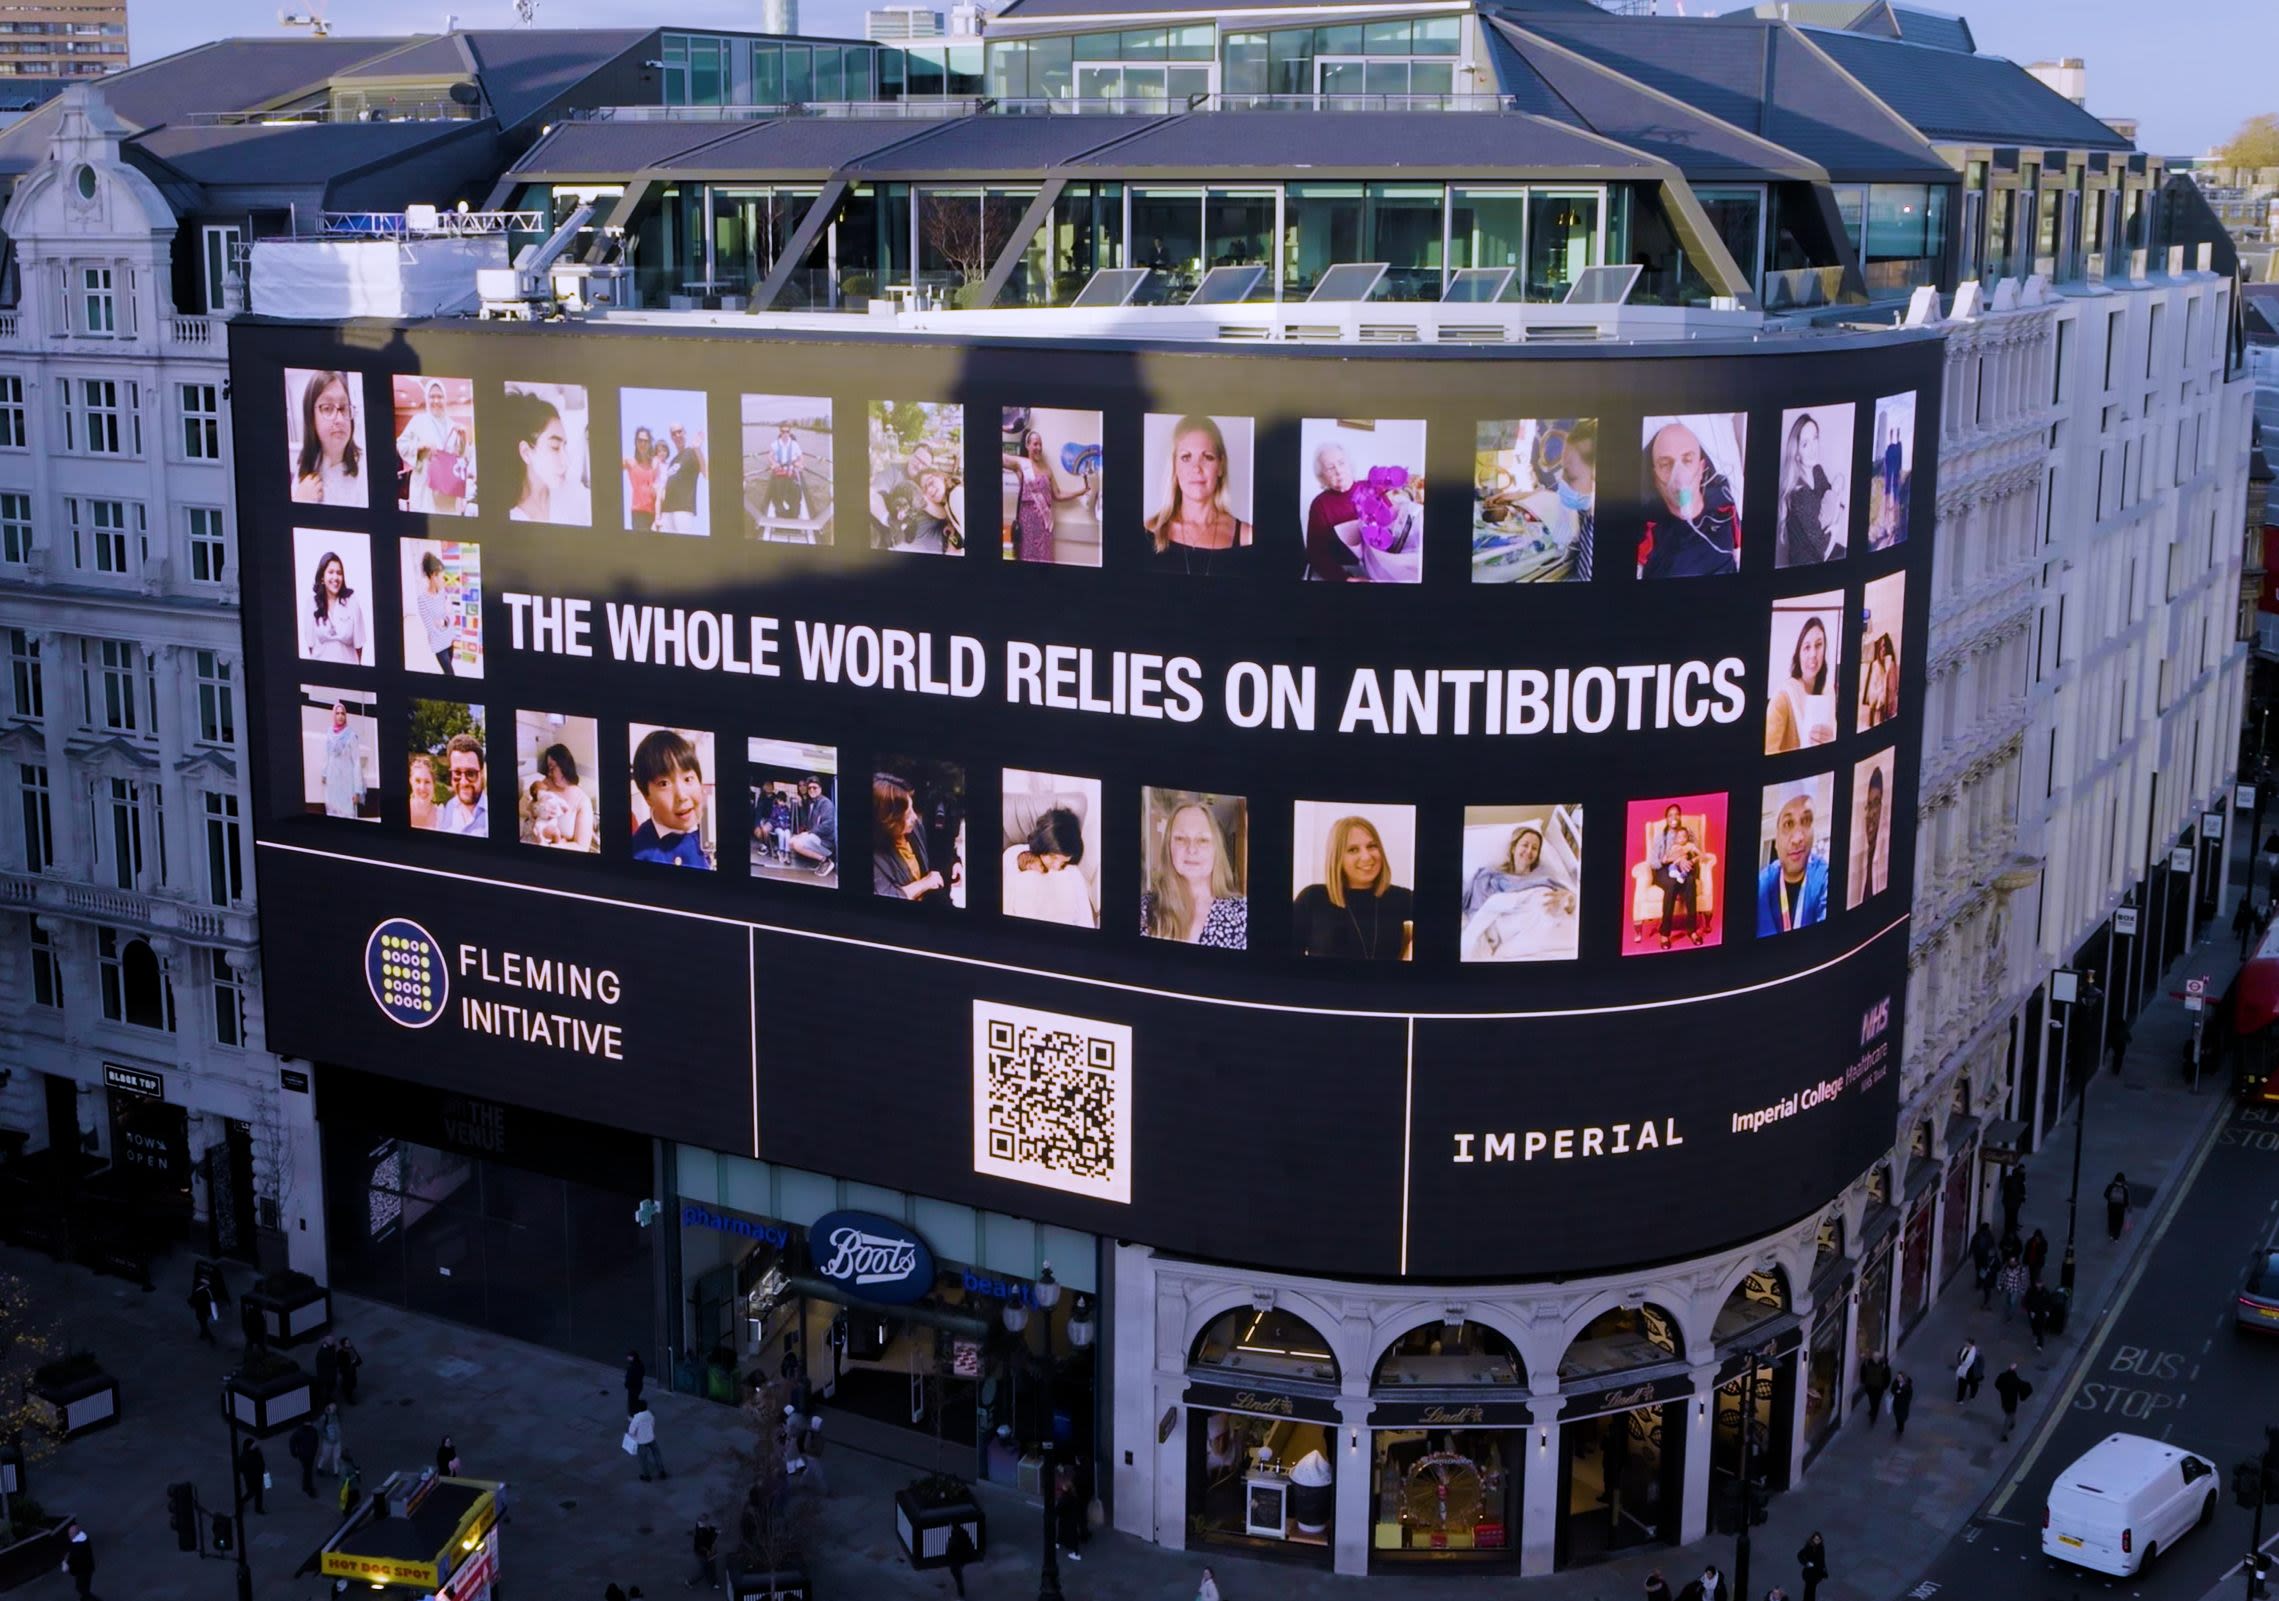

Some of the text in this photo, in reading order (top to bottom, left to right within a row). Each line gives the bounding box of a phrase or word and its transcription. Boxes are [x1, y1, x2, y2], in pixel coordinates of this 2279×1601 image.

[502, 592, 1746, 735] THE WHOLE WORLD RELIES ON ANTIBIOTICS
[460, 944, 621, 1005] FLEMING
[462, 997, 624, 1060] INITIATIVE
[1860, 996, 1890, 1046] NHS
[1732, 1042, 1888, 1133] Imperial College Healthcare
[127, 1151, 168, 1169] OPEN
[1453, 1117, 1684, 1163] IMPERIAL
[683, 1206, 790, 1249] pharmacy
[820, 1227, 917, 1285] Boots
[2109, 1345, 2185, 1379] BUS
[1231, 1391, 1282, 1412] Lindt
[1418, 1405, 1474, 1424] Lindt
[1601, 1386, 1645, 1409] Lindt
[2073, 1382, 2180, 1420] STOP
[328, 1559, 431, 1580] HOT DOG SPOT
